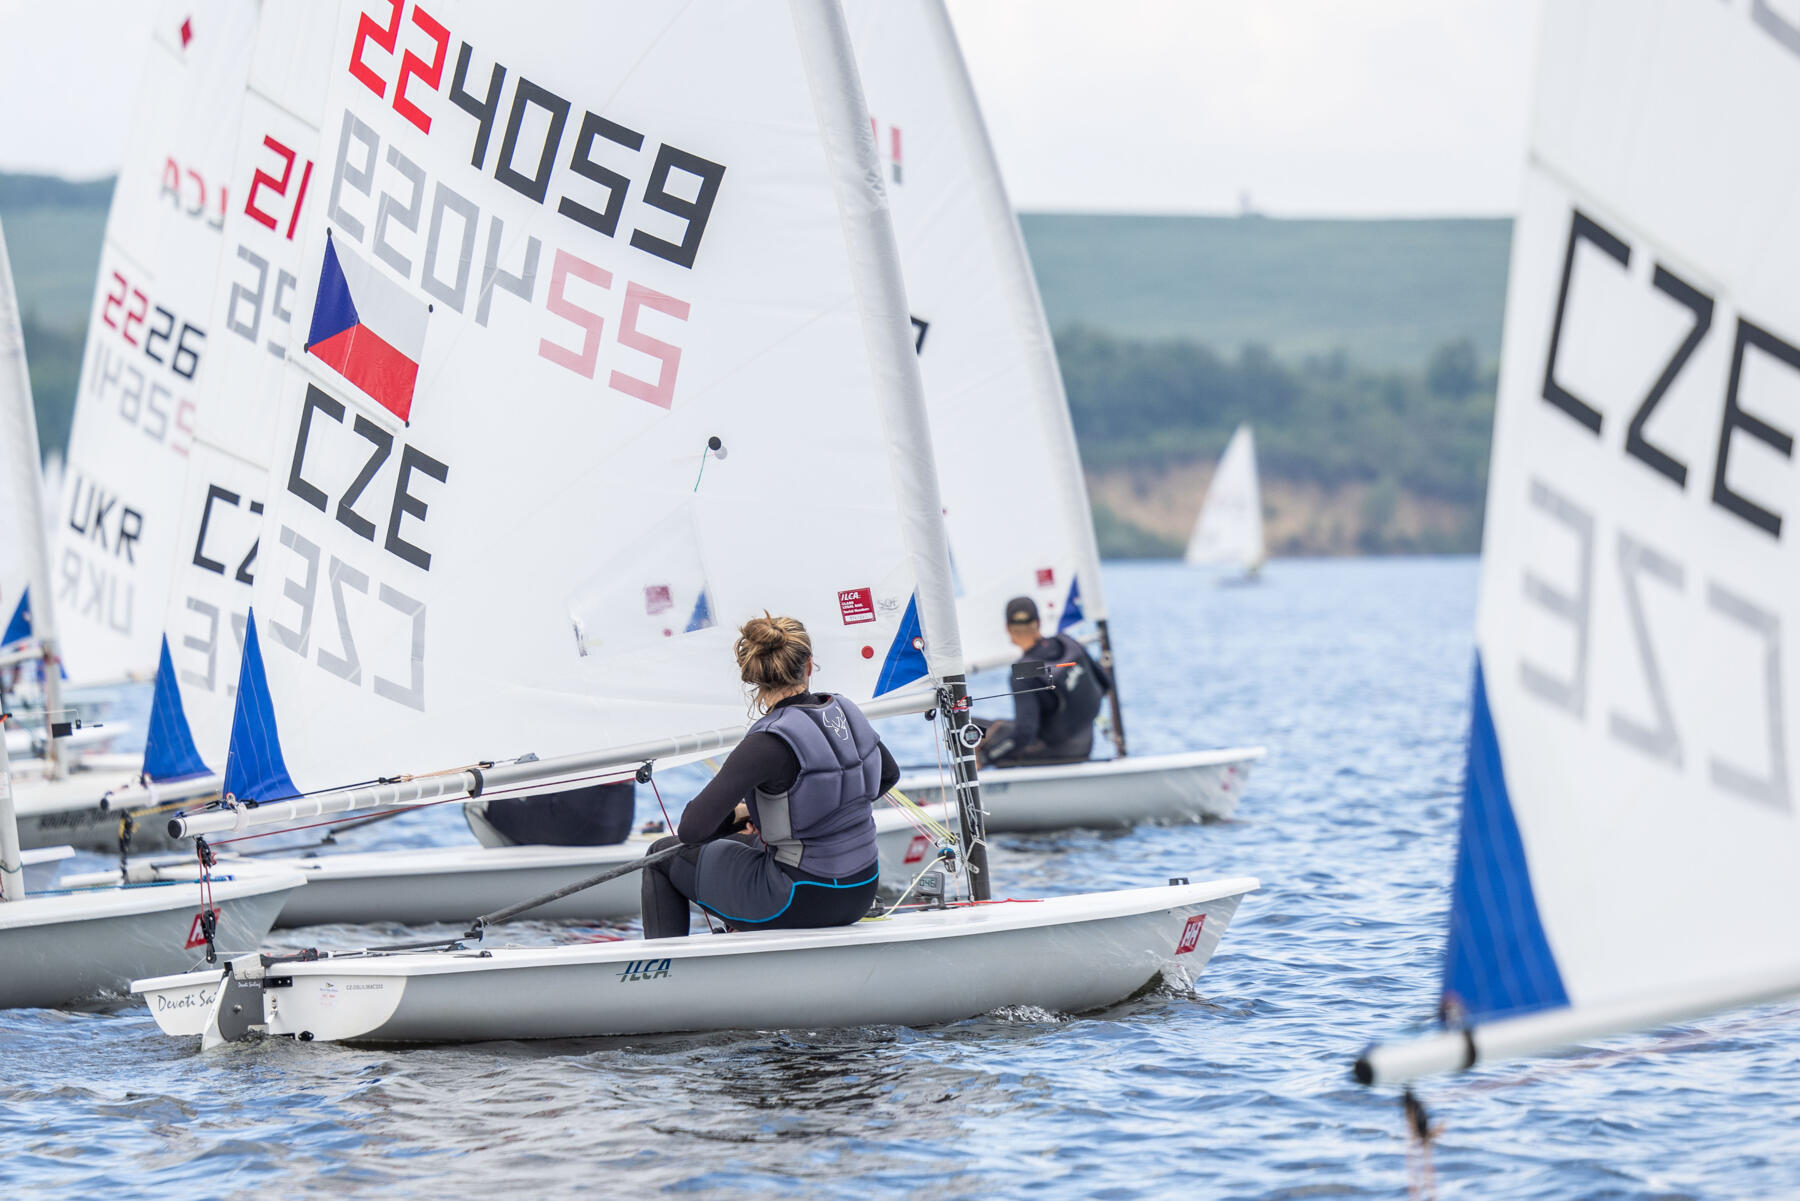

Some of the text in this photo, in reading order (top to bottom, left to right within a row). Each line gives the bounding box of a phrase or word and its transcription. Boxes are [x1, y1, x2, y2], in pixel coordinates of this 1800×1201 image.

[348, 0, 727, 270] 224059
[102, 270, 207, 381] 2226
[1541, 208, 1800, 540] CZE
[69, 474, 144, 565] UKR
[287, 382, 449, 572] CZE
[192, 483, 265, 586] CZ
[157, 989, 217, 1012] Devoti Sai
[620, 958, 672, 983] ILCA
